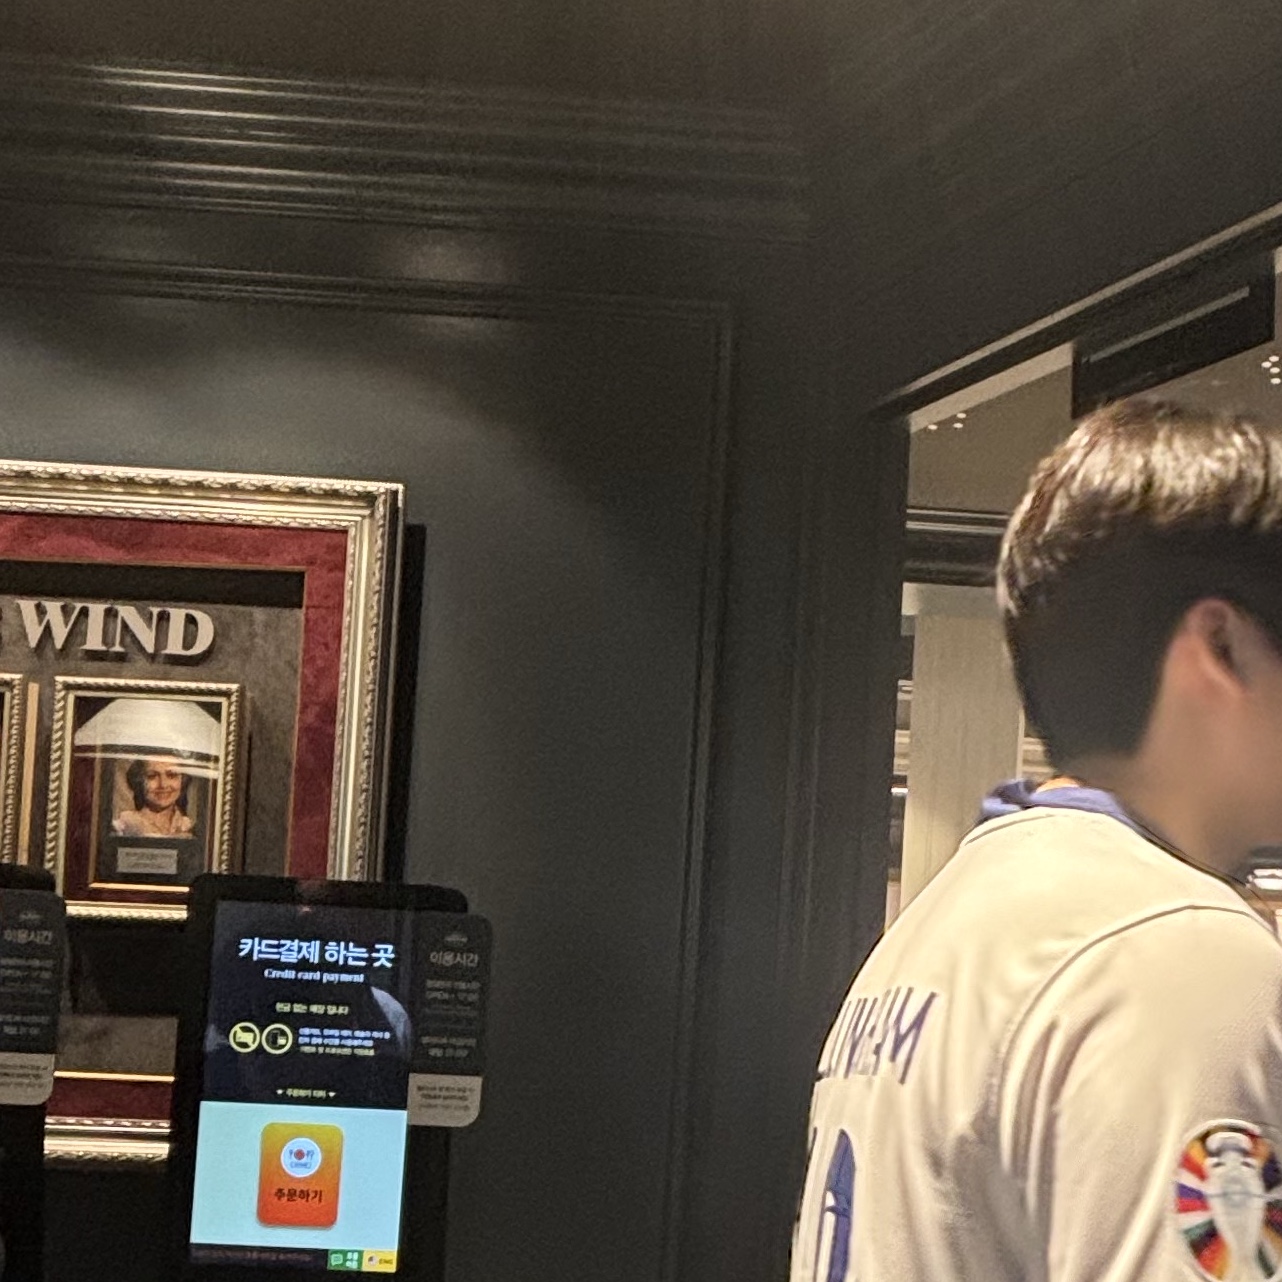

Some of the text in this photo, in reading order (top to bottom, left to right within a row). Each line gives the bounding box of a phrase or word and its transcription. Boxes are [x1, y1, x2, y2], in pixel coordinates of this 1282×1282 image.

[16, 600, 214, 656] WIND
[239, 937, 396, 968] 카드결제 하는 곳
[264, 968, 364, 984] Credit card payment
[274, 1188, 323, 1203] 주문하기
